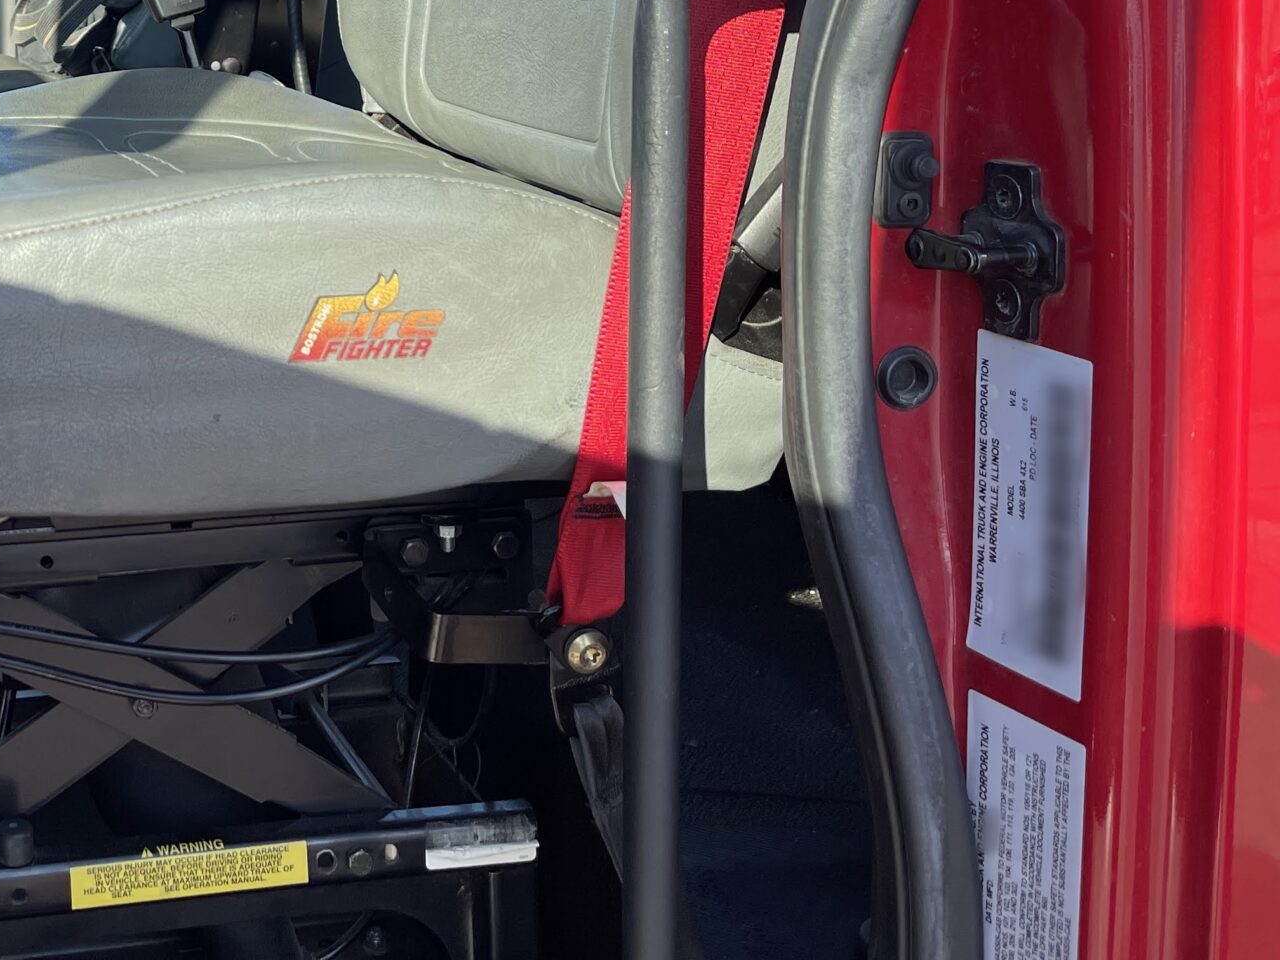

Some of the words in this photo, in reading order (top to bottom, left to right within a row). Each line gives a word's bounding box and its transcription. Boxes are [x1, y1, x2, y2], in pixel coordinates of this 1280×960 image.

[301, 303, 332, 356] BOSTROM
[321, 338, 432, 362] FIGHTER
[980, 358, 989, 436] CORPORATION
[979, 437, 987, 478] ENGINE
[991, 438, 999, 482] ILLINOIS
[978, 479, 986, 503] AND
[977, 503, 986, 539] TRUCK
[989, 485, 999, 563] WARRENVILLE,
[974, 544, 985, 627] INTERNATIONAL
[979, 723, 989, 801] CORPORATION
[1025, 769, 1031, 781] OR
[1056, 764, 1062, 776] TO
[1063, 749, 1071, 765] THE
[1063, 768, 1069, 780] BY
[1031, 752, 1039, 811] INSTRUCTIONS
[1038, 760, 1046, 806] FURNISHED
[1054, 777, 1062, 829] APPLICABLE
[1061, 780, 1069, 824] AFFECTED
[156, 839, 224, 856] WARNING
[1036, 806, 1045, 853] DOCUMENT
[87, 864, 123, 875] SERIOUS
[125, 861, 153, 870] INJURY
[175, 856, 204, 864] OCCUR
[240, 845, 289, 857] CLEARANCE
[144, 872, 176, 881] ENSURE
[179, 868, 200, 876] THAT
[202, 865, 228, 875] THERE
[239, 861, 282, 870] ADEQUATE
[171, 862, 204, 871] BEFORE
[206, 858, 239, 867] DRIVING
[255, 853, 283, 862] RIDING
[998, 859, 1004, 870] TO
[1021, 833, 1029, 876] STANDARD
[1028, 833, 1036, 889] ACCORDANCE
[1035, 853, 1043, 886] VEHICLE
[1051, 830, 1060, 880] STANDARDS
[1059, 825, 1067, 891] SUBSTANTIALLY
[84, 887, 107, 895] HEAD
[108, 881, 158, 893] CLEARANCE
[173, 875, 212, 884] MAXIMUM
[213, 871, 249, 880] UPWARD
[250, 867, 281, 875] TRAVEL
[283, 864, 294, 872] OF
[182, 880, 229, 890] OPERATION
[1021, 879, 1027, 888] TO
[1050, 881, 1058, 912] SAFETY
